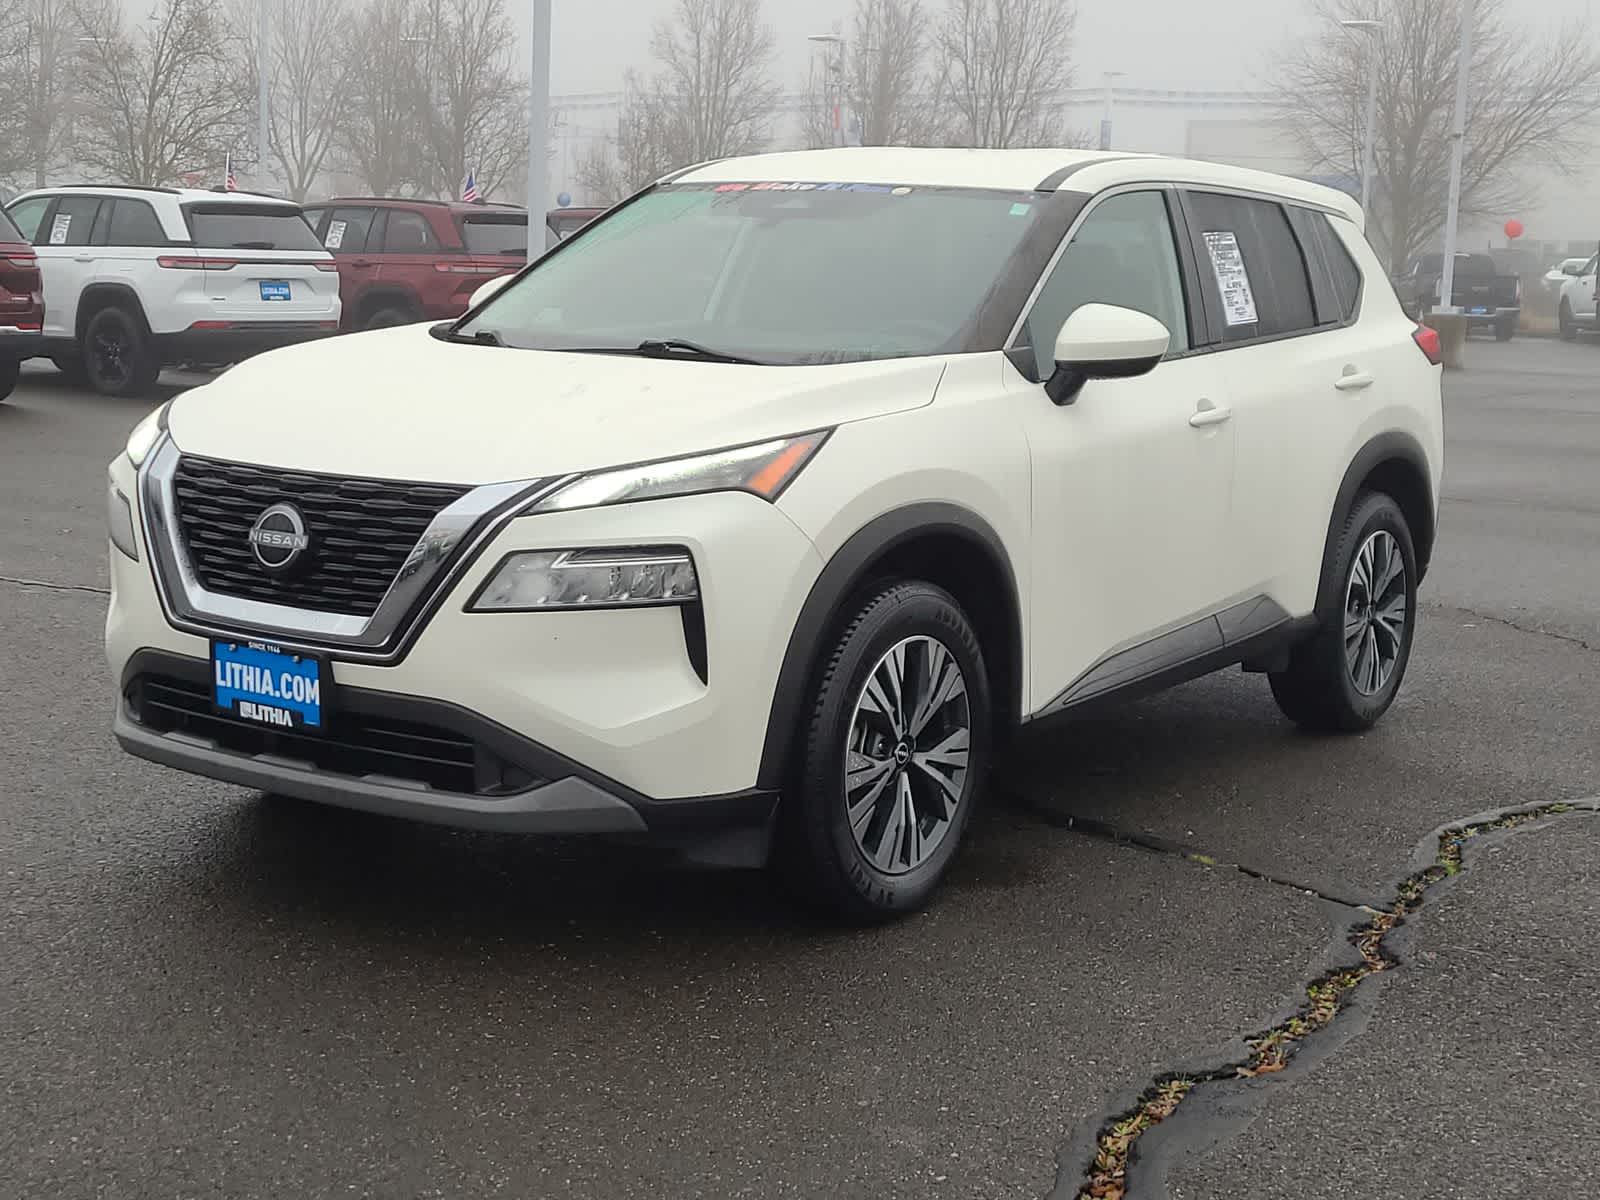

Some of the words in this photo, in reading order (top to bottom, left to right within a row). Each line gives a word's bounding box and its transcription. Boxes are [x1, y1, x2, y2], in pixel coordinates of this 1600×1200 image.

[249, 530, 305, 547] NISSAN
[215, 659, 320, 706] LITHIA.COM
[253, 703, 293, 726] LITHIA
